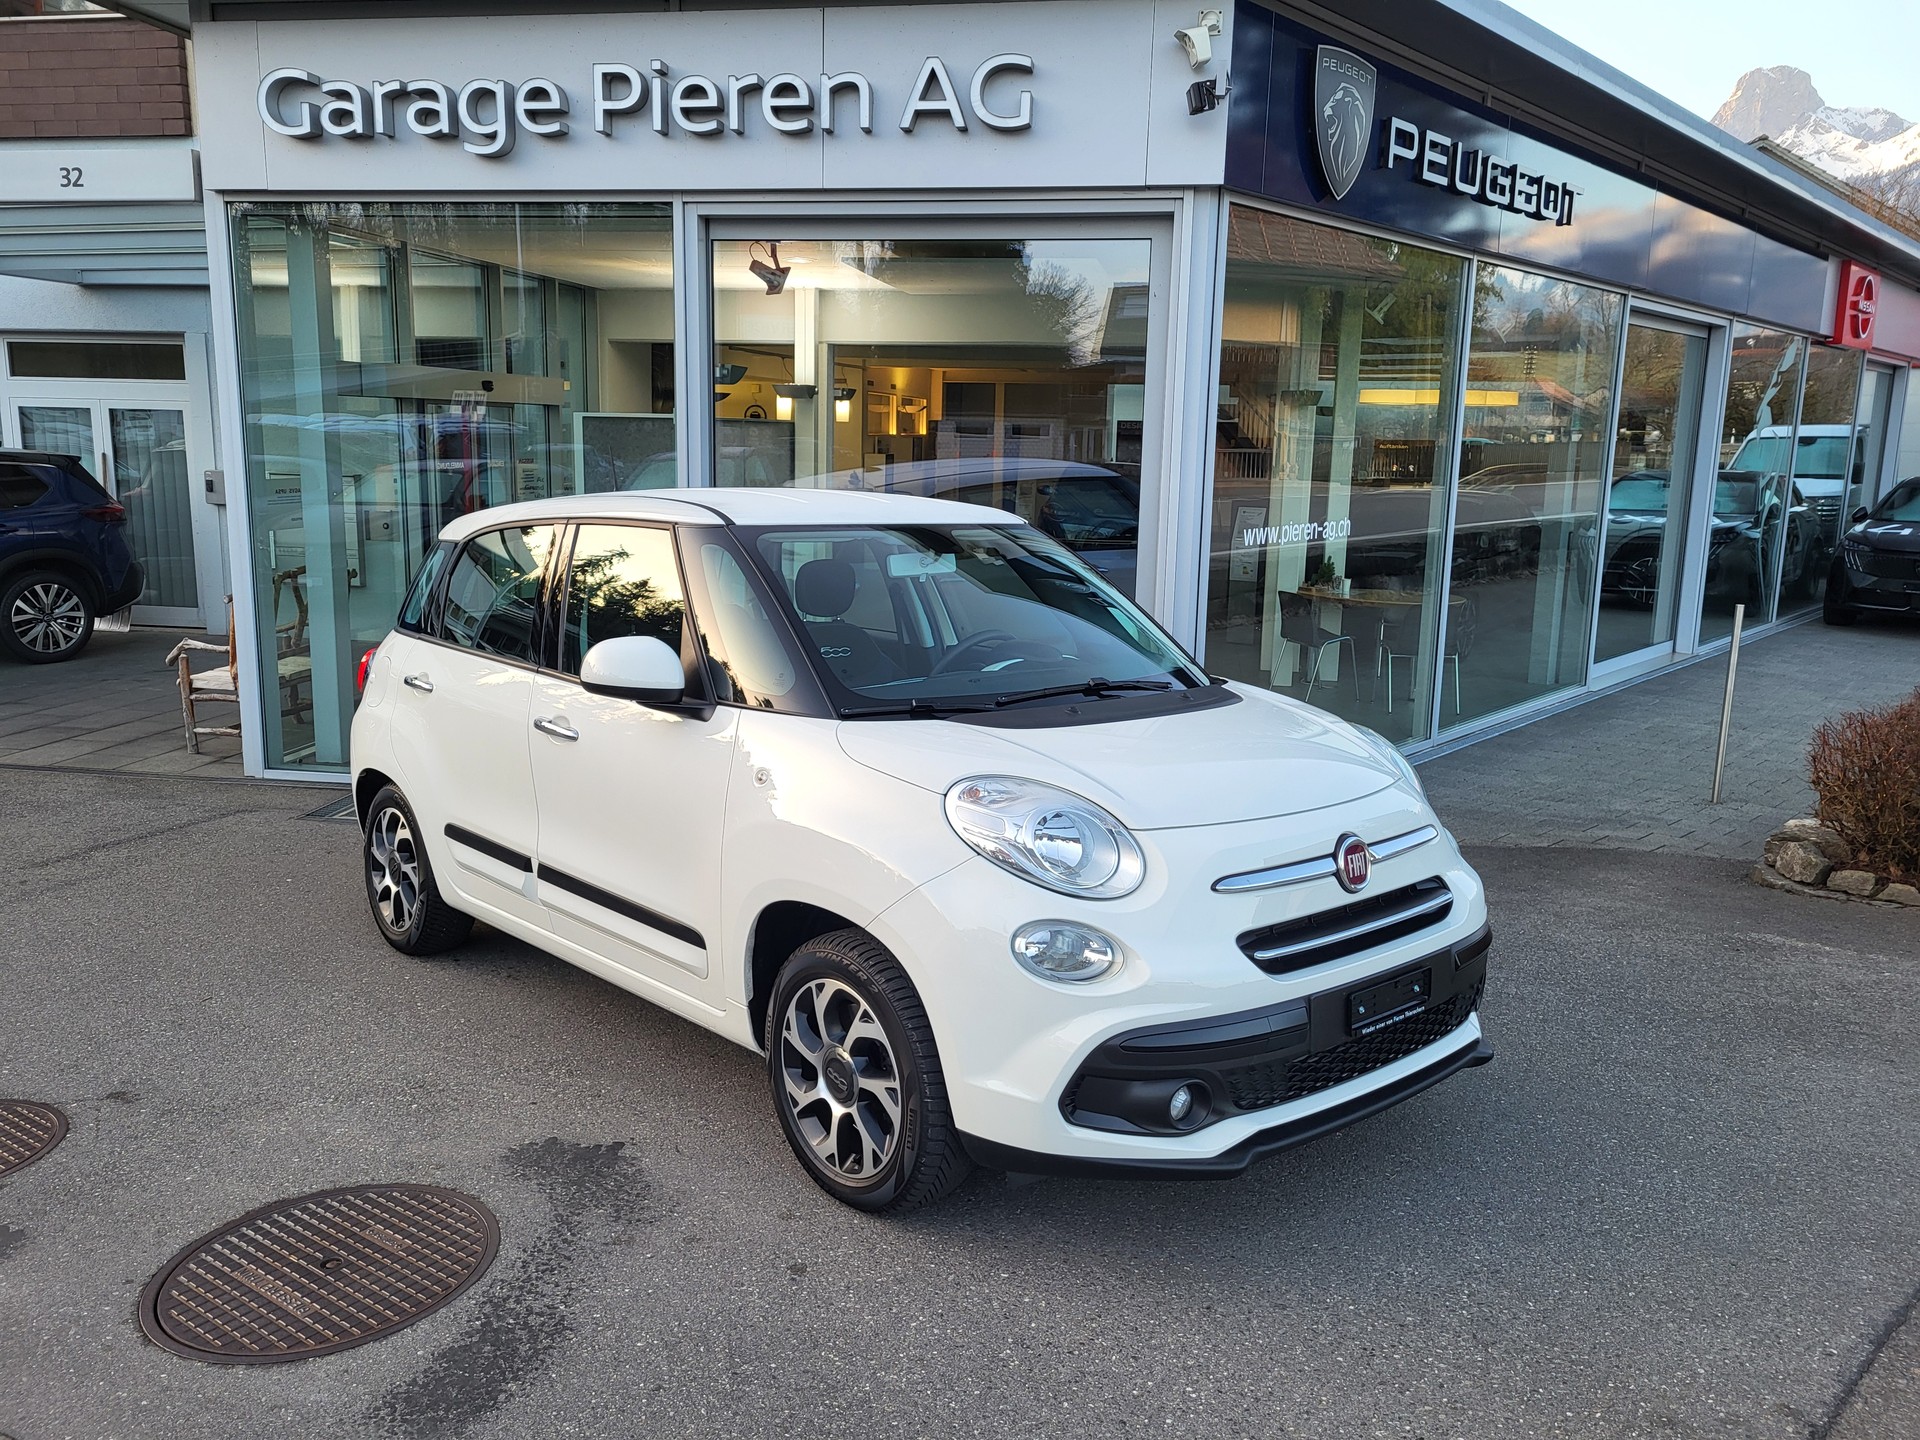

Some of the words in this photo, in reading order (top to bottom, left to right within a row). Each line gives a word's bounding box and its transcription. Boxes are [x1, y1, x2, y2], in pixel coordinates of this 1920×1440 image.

[1322, 57, 1373, 84] PEUGEOT
[257, 67, 569, 157] Garage
[593, 59, 873, 136] Pieren
[899, 53, 1035, 134] AG
[59, 167, 84, 188] 32
[1385, 116, 1585, 226] PEUGEOT
[1860, 300, 1875, 314] NISSAN
[1243, 517, 1351, 546] www.pieren-ag.ch
[820, 646, 852, 658] 500
[1347, 851, 1366, 878] FIAT
[816, 951, 868, 981] WINTER
[867, 984, 879, 993] 2
